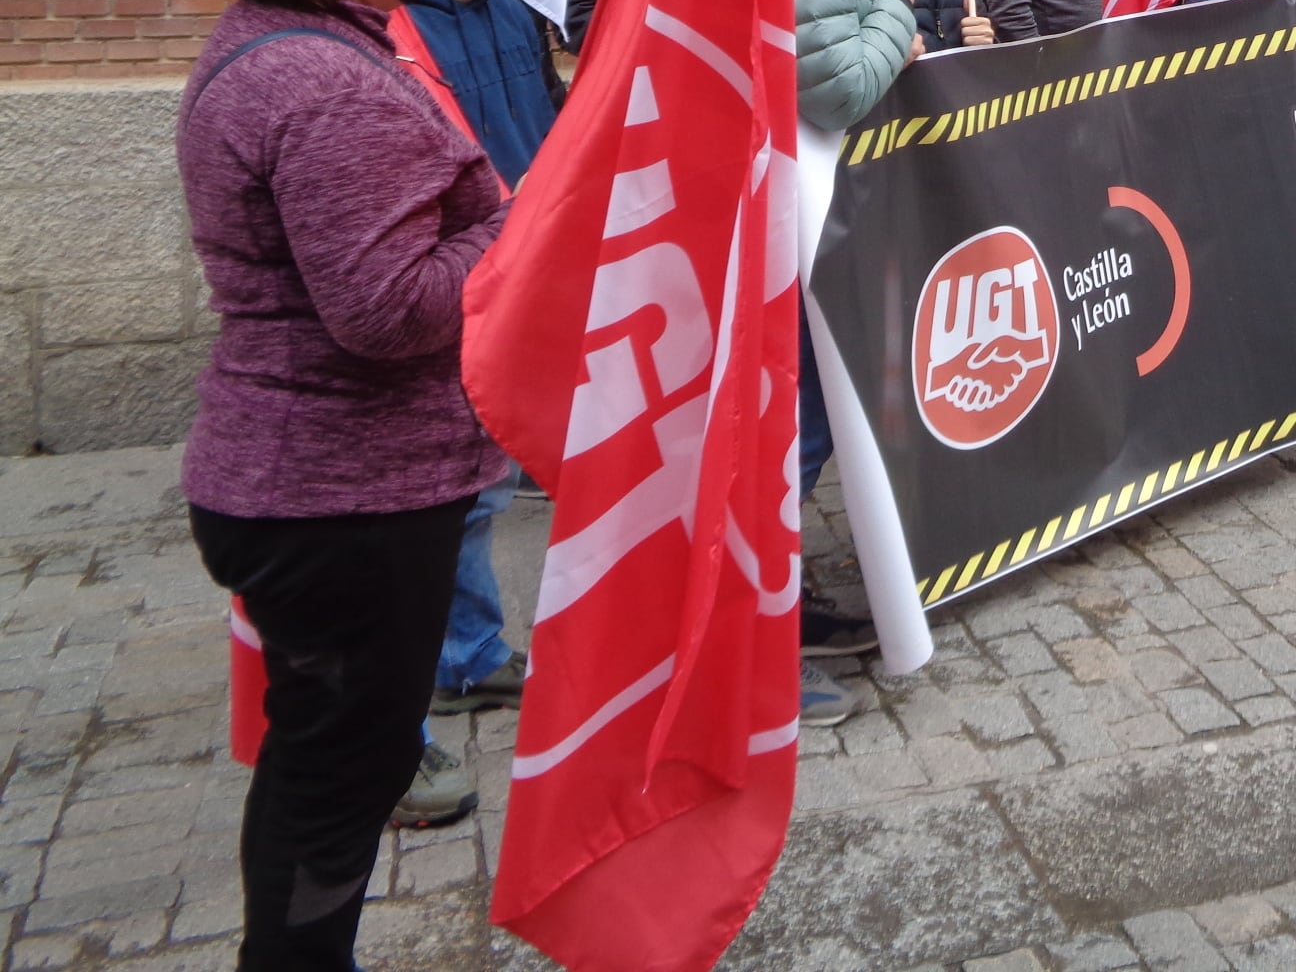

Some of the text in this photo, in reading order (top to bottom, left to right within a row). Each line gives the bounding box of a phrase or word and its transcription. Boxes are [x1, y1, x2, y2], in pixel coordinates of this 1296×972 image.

[931, 259, 1046, 350] UGT
[1063, 248, 1133, 302] Castilla
[1070, 288, 1131, 350] y León
